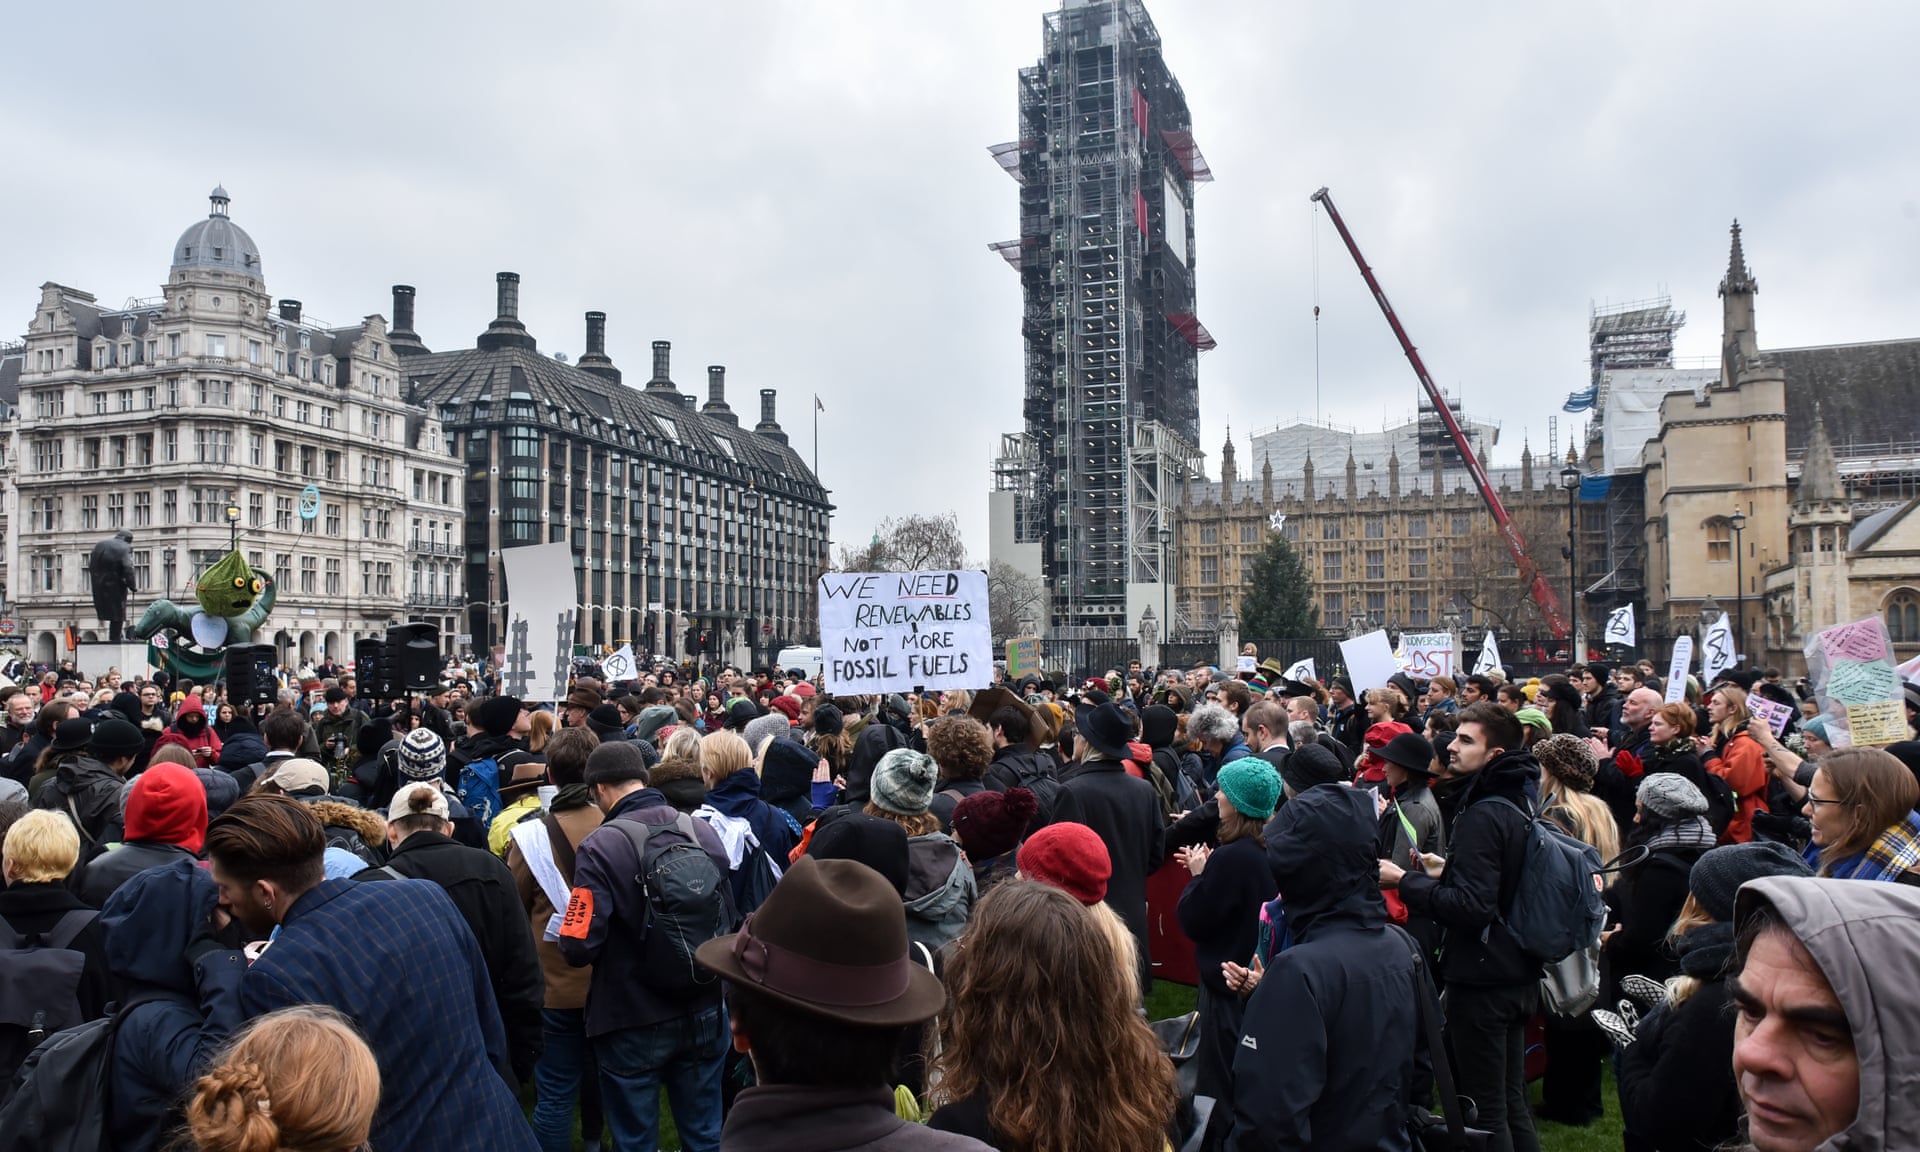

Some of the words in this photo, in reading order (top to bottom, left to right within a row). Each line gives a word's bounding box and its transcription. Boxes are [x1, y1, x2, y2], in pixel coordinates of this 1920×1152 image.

[821, 576, 880, 599] WE
[898, 573, 959, 596] NEED
[855, 603, 971, 628] RENEWABLES
[844, 637, 883, 653] NOT
[902, 632, 954, 649] MORE
[833, 656, 897, 682] FOSSIL
[908, 653, 969, 678] FUELS
[564, 894, 580, 926] ECOCIDE
[576, 901, 587, 923] LAW
